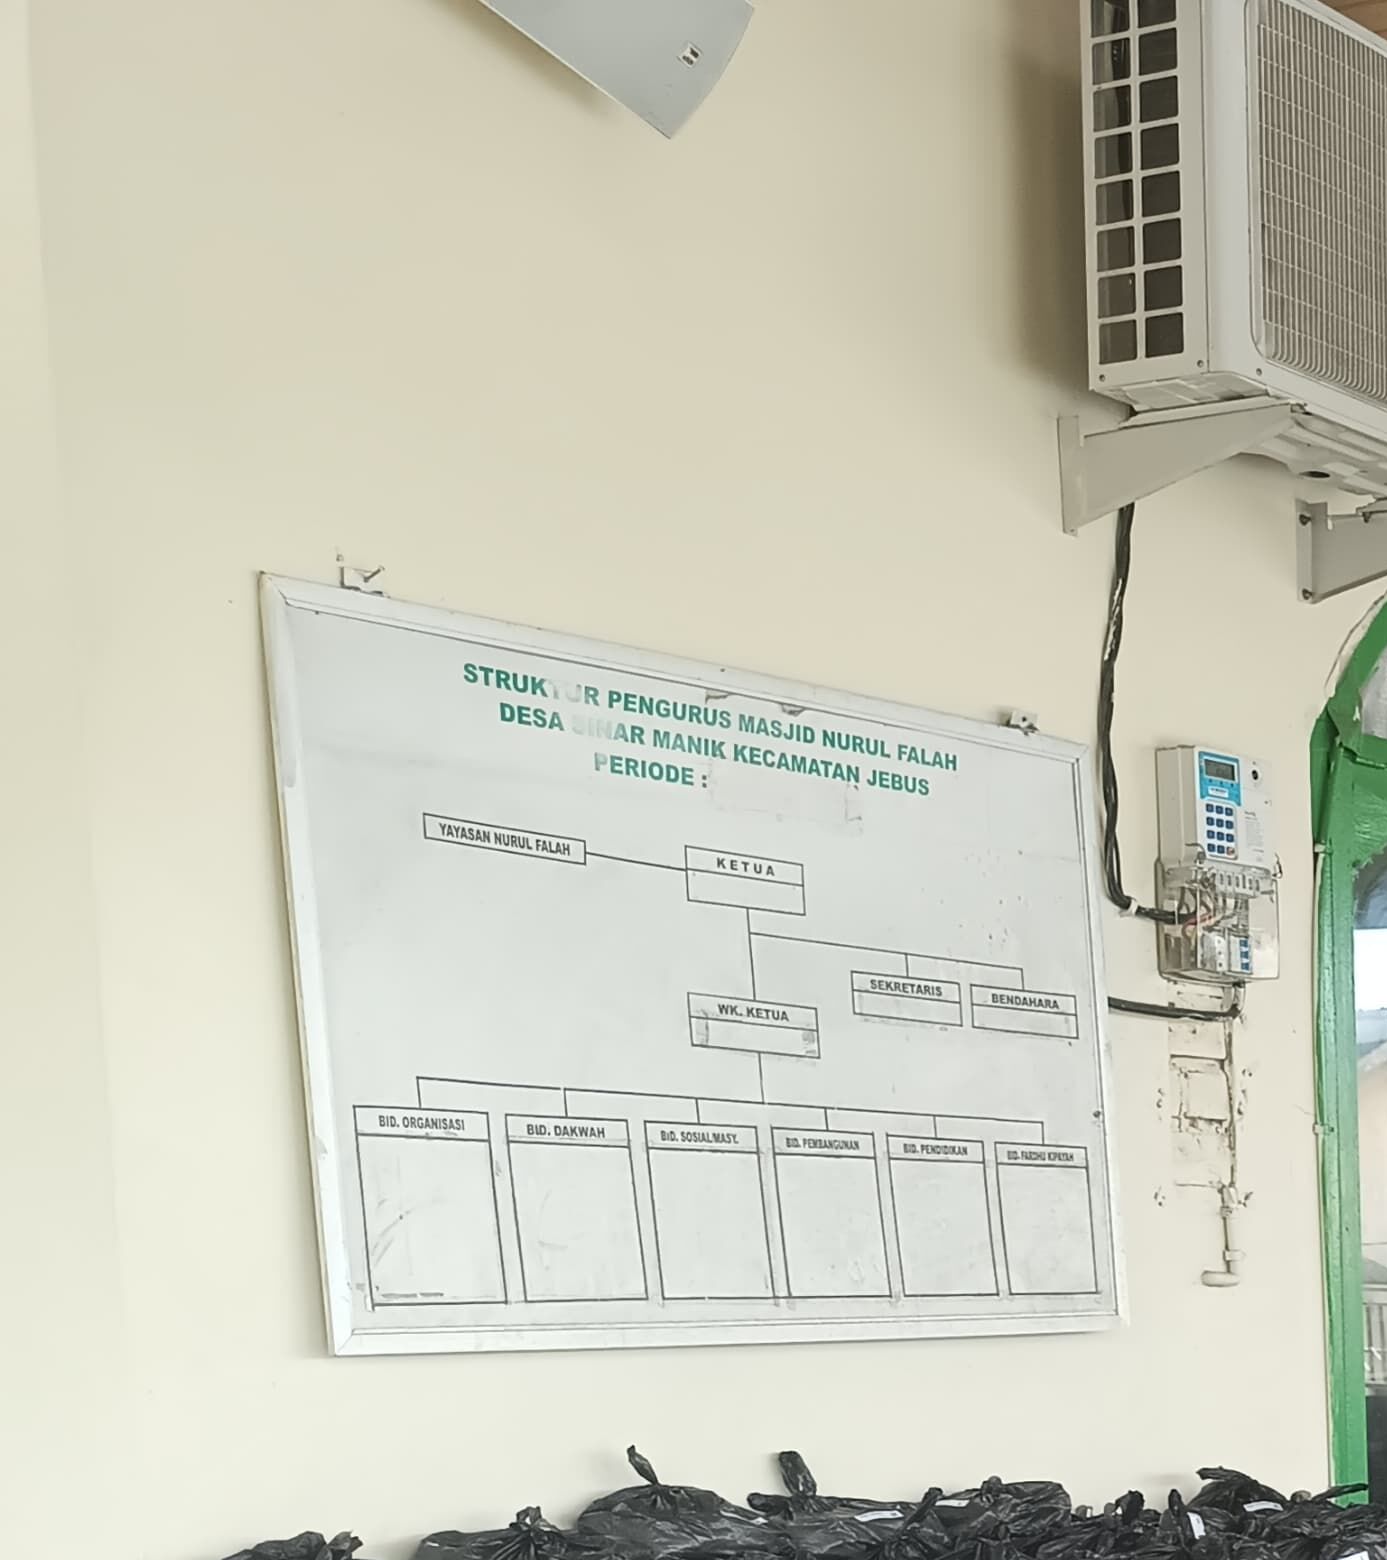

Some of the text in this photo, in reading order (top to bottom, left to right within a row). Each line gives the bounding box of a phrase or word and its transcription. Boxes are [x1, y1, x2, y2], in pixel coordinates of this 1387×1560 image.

[463, 663, 957, 771] STRUKTUR PENGURUS MASJID NURUL FALAH
[499, 702, 565, 732] DESA
[652, 729, 726, 760] MANIK
[734, 744, 860, 783] KECAMATAN
[867, 769, 929, 796] JEBUS
[594, 752, 695, 786] PERIODE
[439, 822, 571, 856] YAYASAN NURUL FALAH
[869, 979, 943, 997] SEKRETARIS
[991, 992, 1060, 1010] BENDAHARA
[717, 1003, 790, 1022] WK. KETUA
[378, 1115, 465, 1131] BID. ORGANISASI
[526, 1123, 606, 1139] BID. DAKWAH
[660, 1130, 679, 1142] BID.
